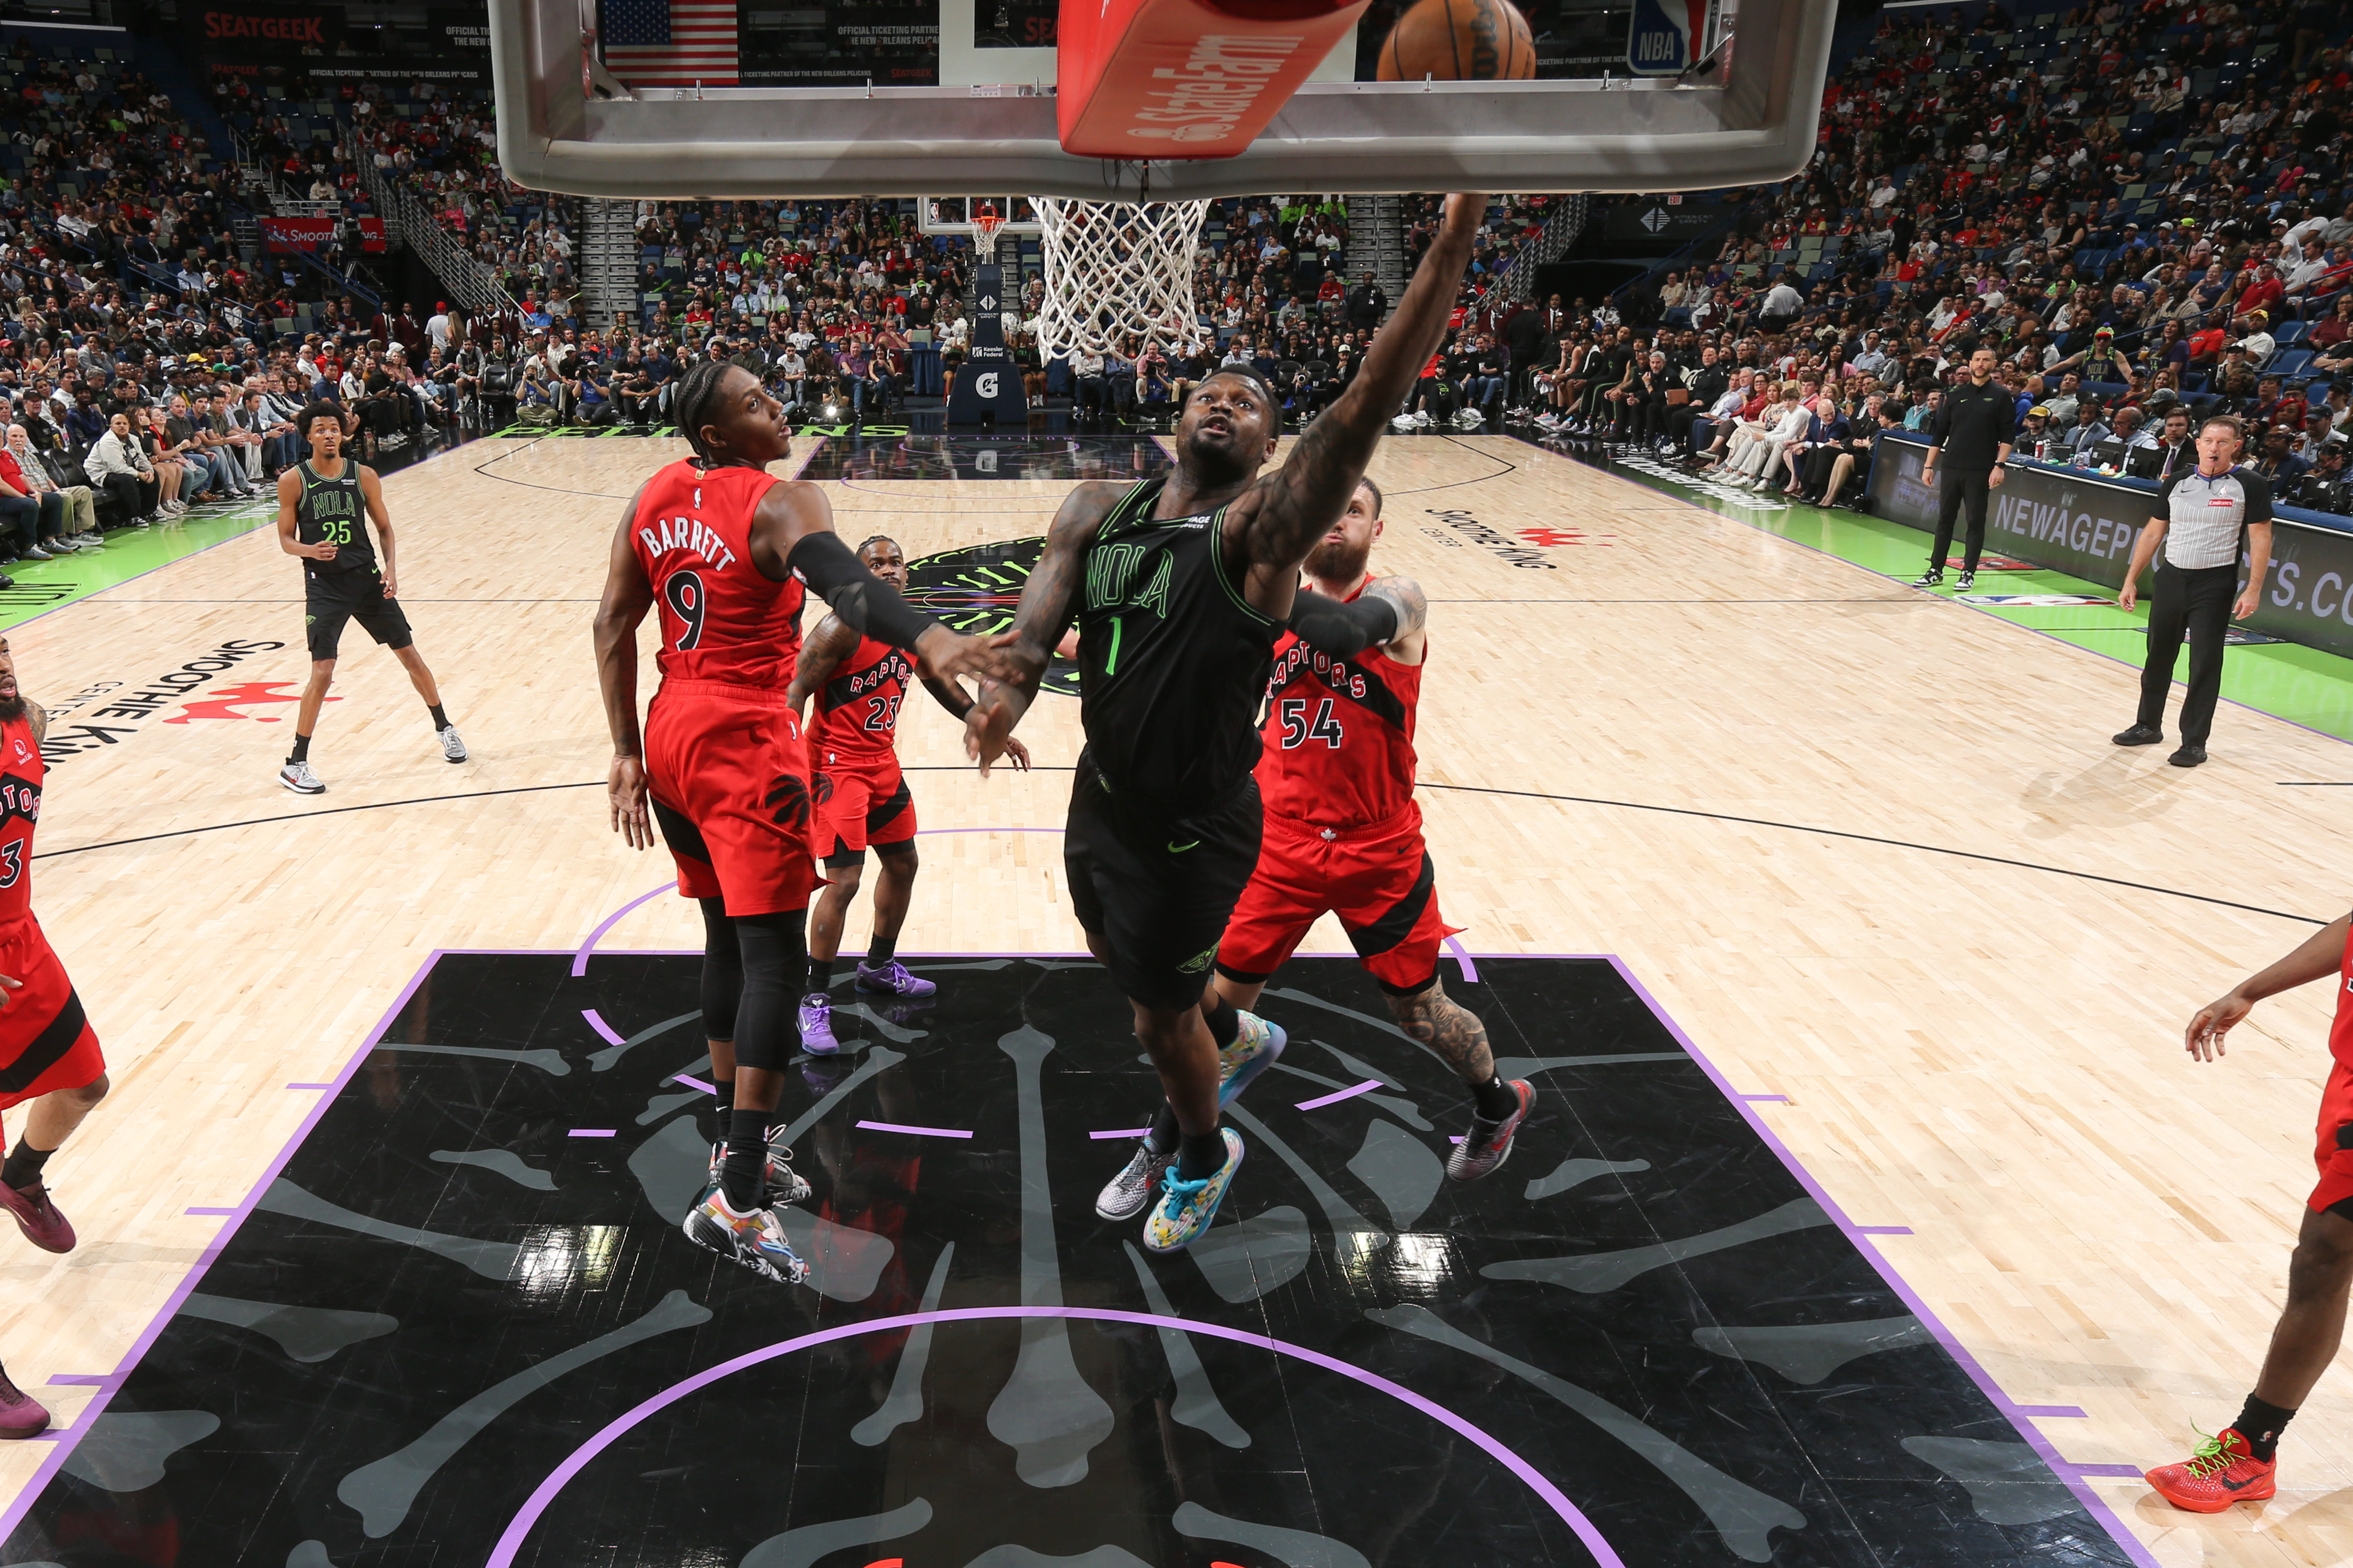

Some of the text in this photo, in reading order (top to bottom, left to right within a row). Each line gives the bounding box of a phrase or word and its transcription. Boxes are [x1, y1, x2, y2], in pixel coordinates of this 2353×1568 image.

[205, 12, 325, 43] SEATGEEK
[446, 26, 479, 35] OFFICIAL
[453, 37, 468, 46] THE
[469, 38, 484, 46] NEW
[838, 26, 939, 35] OFFICIAL TICKETING PARTNE
[860, 37, 877, 45] NEW
[880, 37, 911, 45] RLEANS
[1638, 32, 1675, 61] NBA
[891, 68, 933, 78] SEATGEEK
[2087, 364, 2109, 376] NOLA
[484, 425, 909, 438] PELINS
[312, 490, 356, 520] NOLA
[322, 520, 351, 546] 25
[1419, 527, 1463, 547] CENTER
[1424, 509, 1517, 546] SMOOTHIE
[639, 517, 737, 571] BARRETT
[1086, 543, 1174, 619] NOLA
[665, 570, 705, 652] 9
[1105, 616, 1123, 676] 1
[90, 639, 285, 720] SMOOTHIE
[864, 695, 902, 731] 23
[1281, 698, 1344, 750] 54
